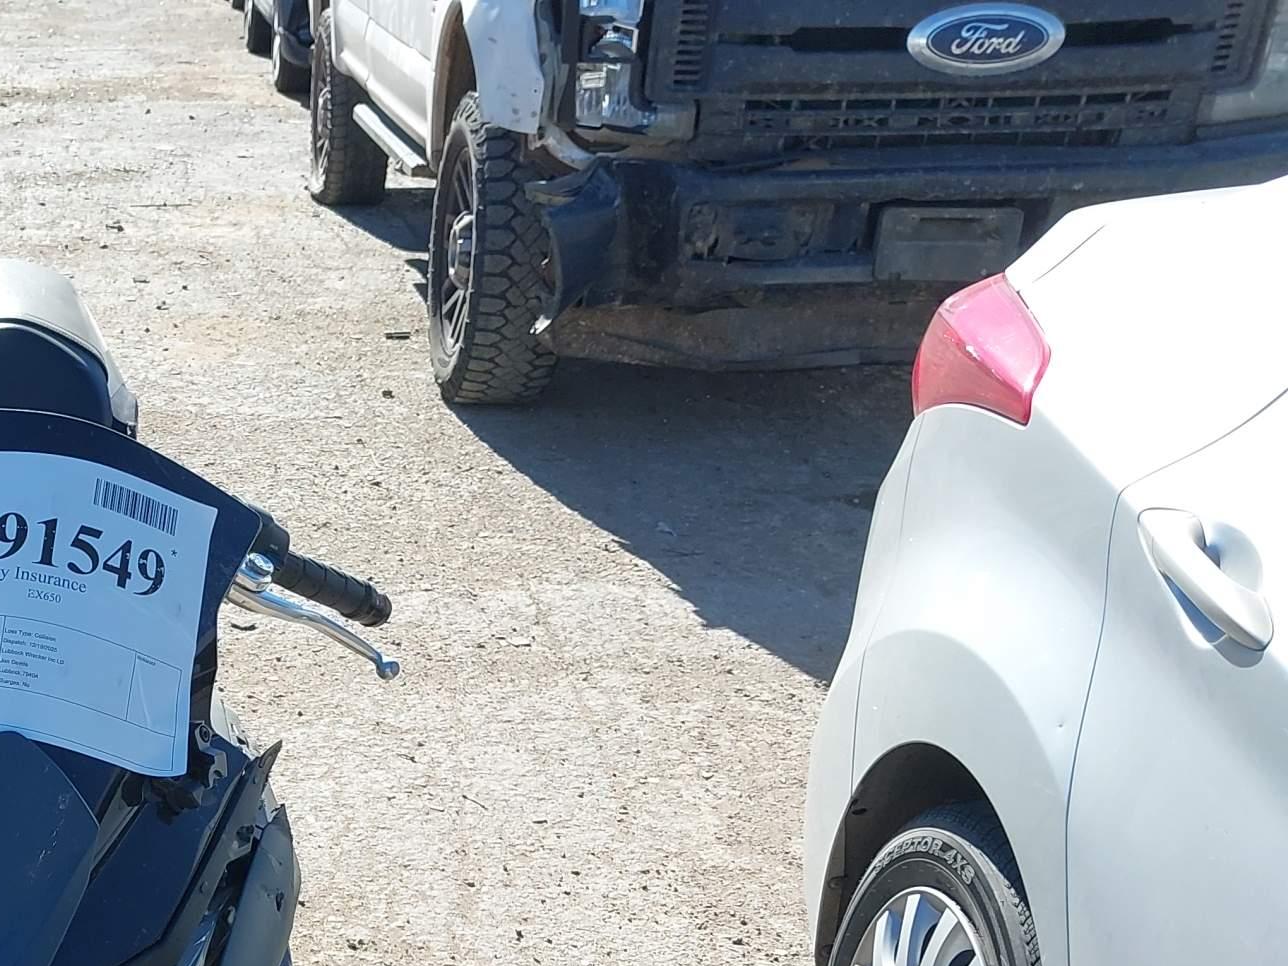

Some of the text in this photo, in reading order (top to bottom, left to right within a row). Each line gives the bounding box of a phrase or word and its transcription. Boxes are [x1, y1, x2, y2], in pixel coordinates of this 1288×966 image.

[950, 22, 1025, 54] Ford
[15, 566, 87, 593] Insurance
[27, 588, 62, 603] EX650
